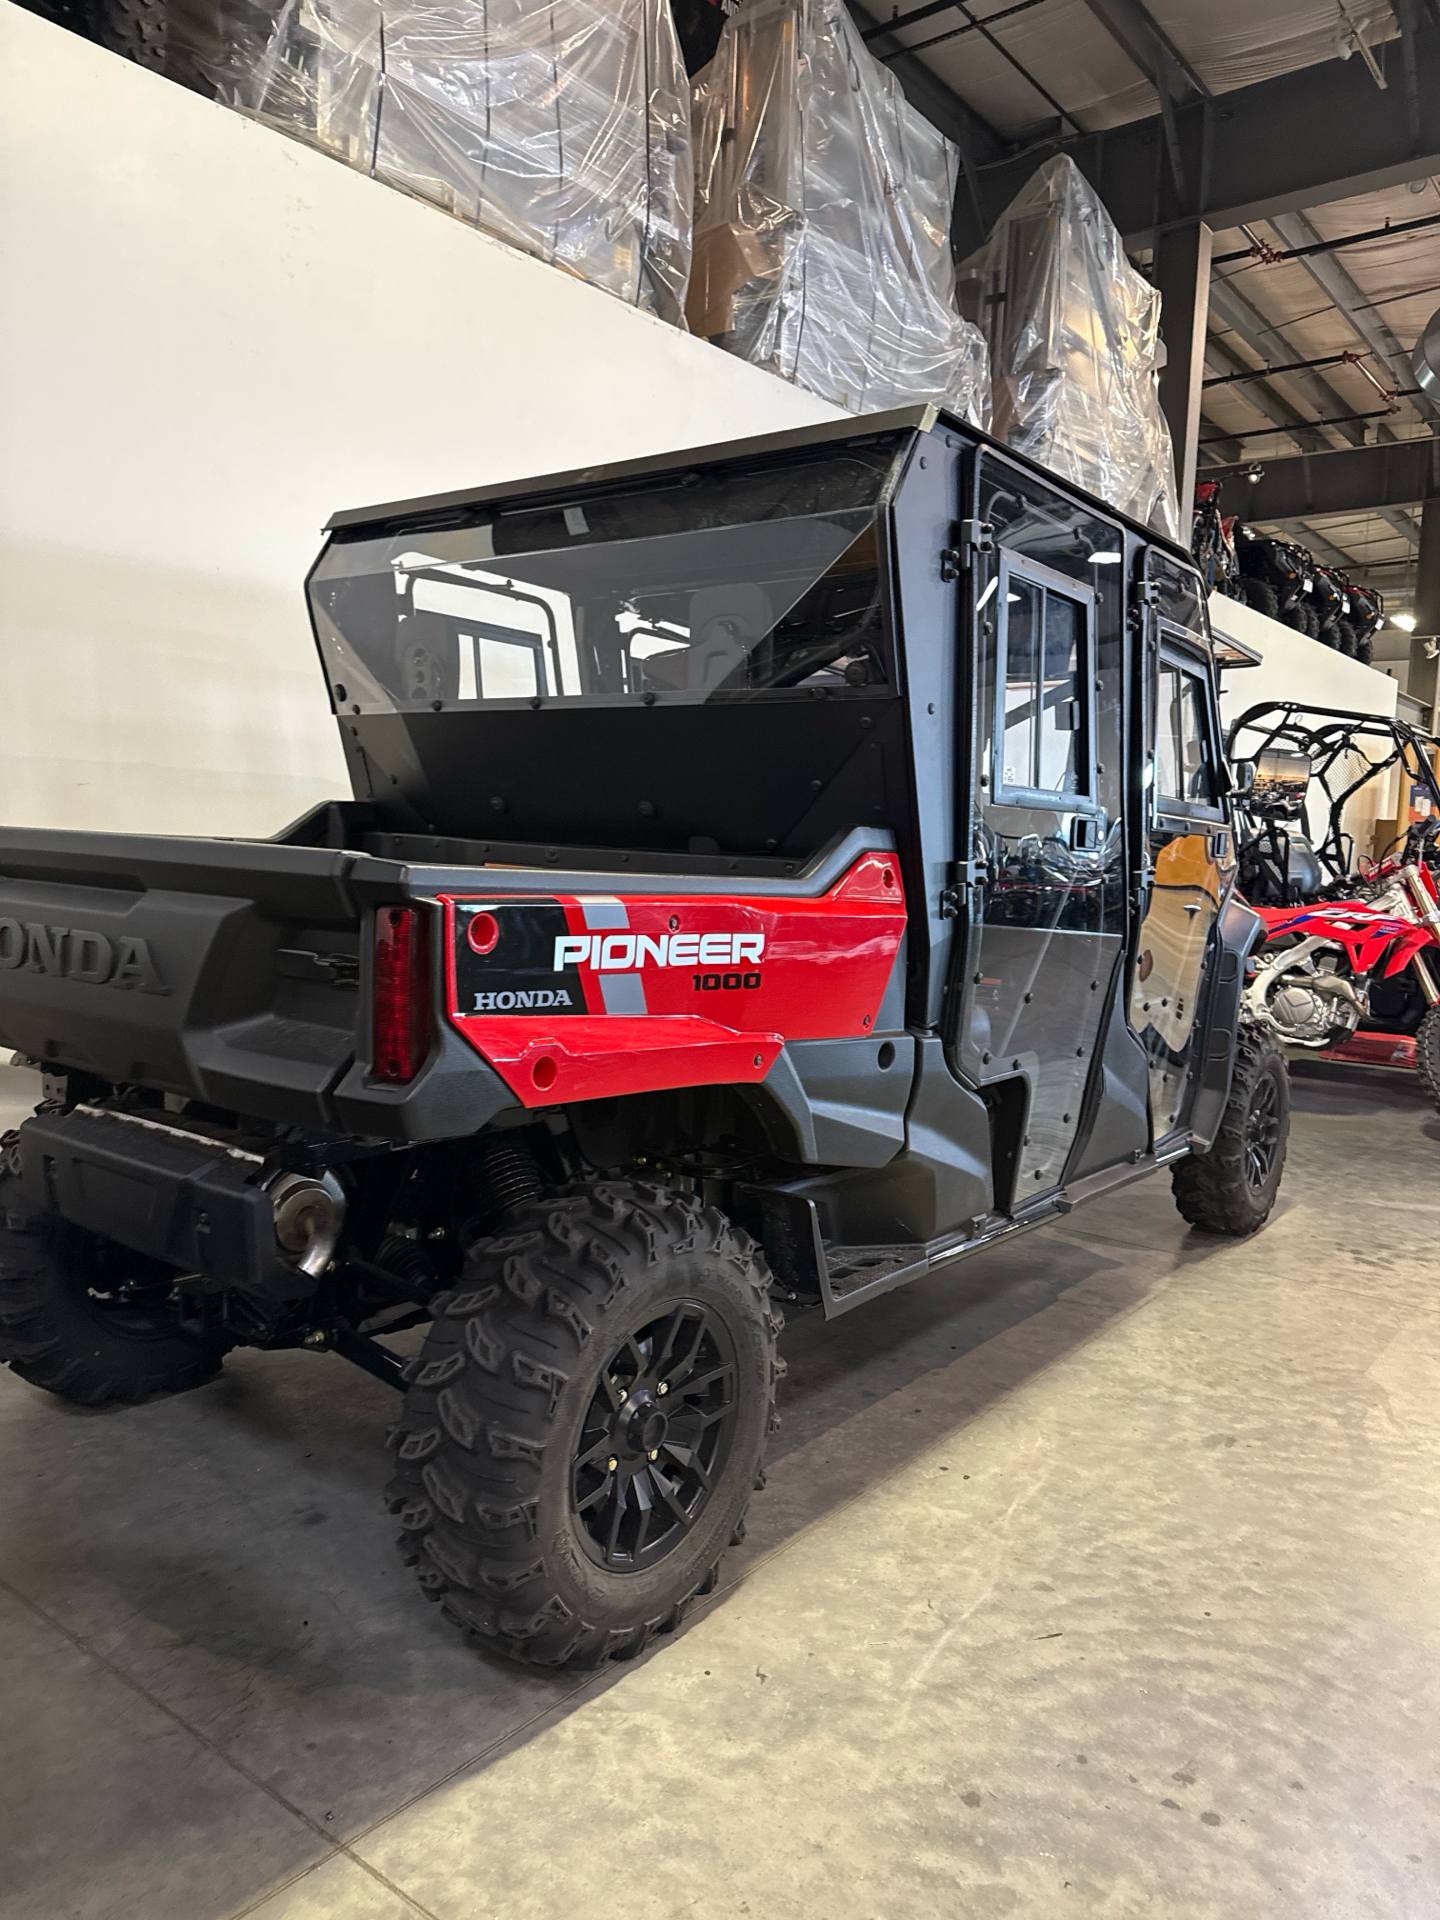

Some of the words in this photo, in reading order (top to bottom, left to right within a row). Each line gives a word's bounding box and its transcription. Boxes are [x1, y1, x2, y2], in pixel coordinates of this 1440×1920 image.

[553, 933, 765, 972] PIONEER
[692, 973, 762, 991] 1000
[473, 989, 573, 1011] HONDA
